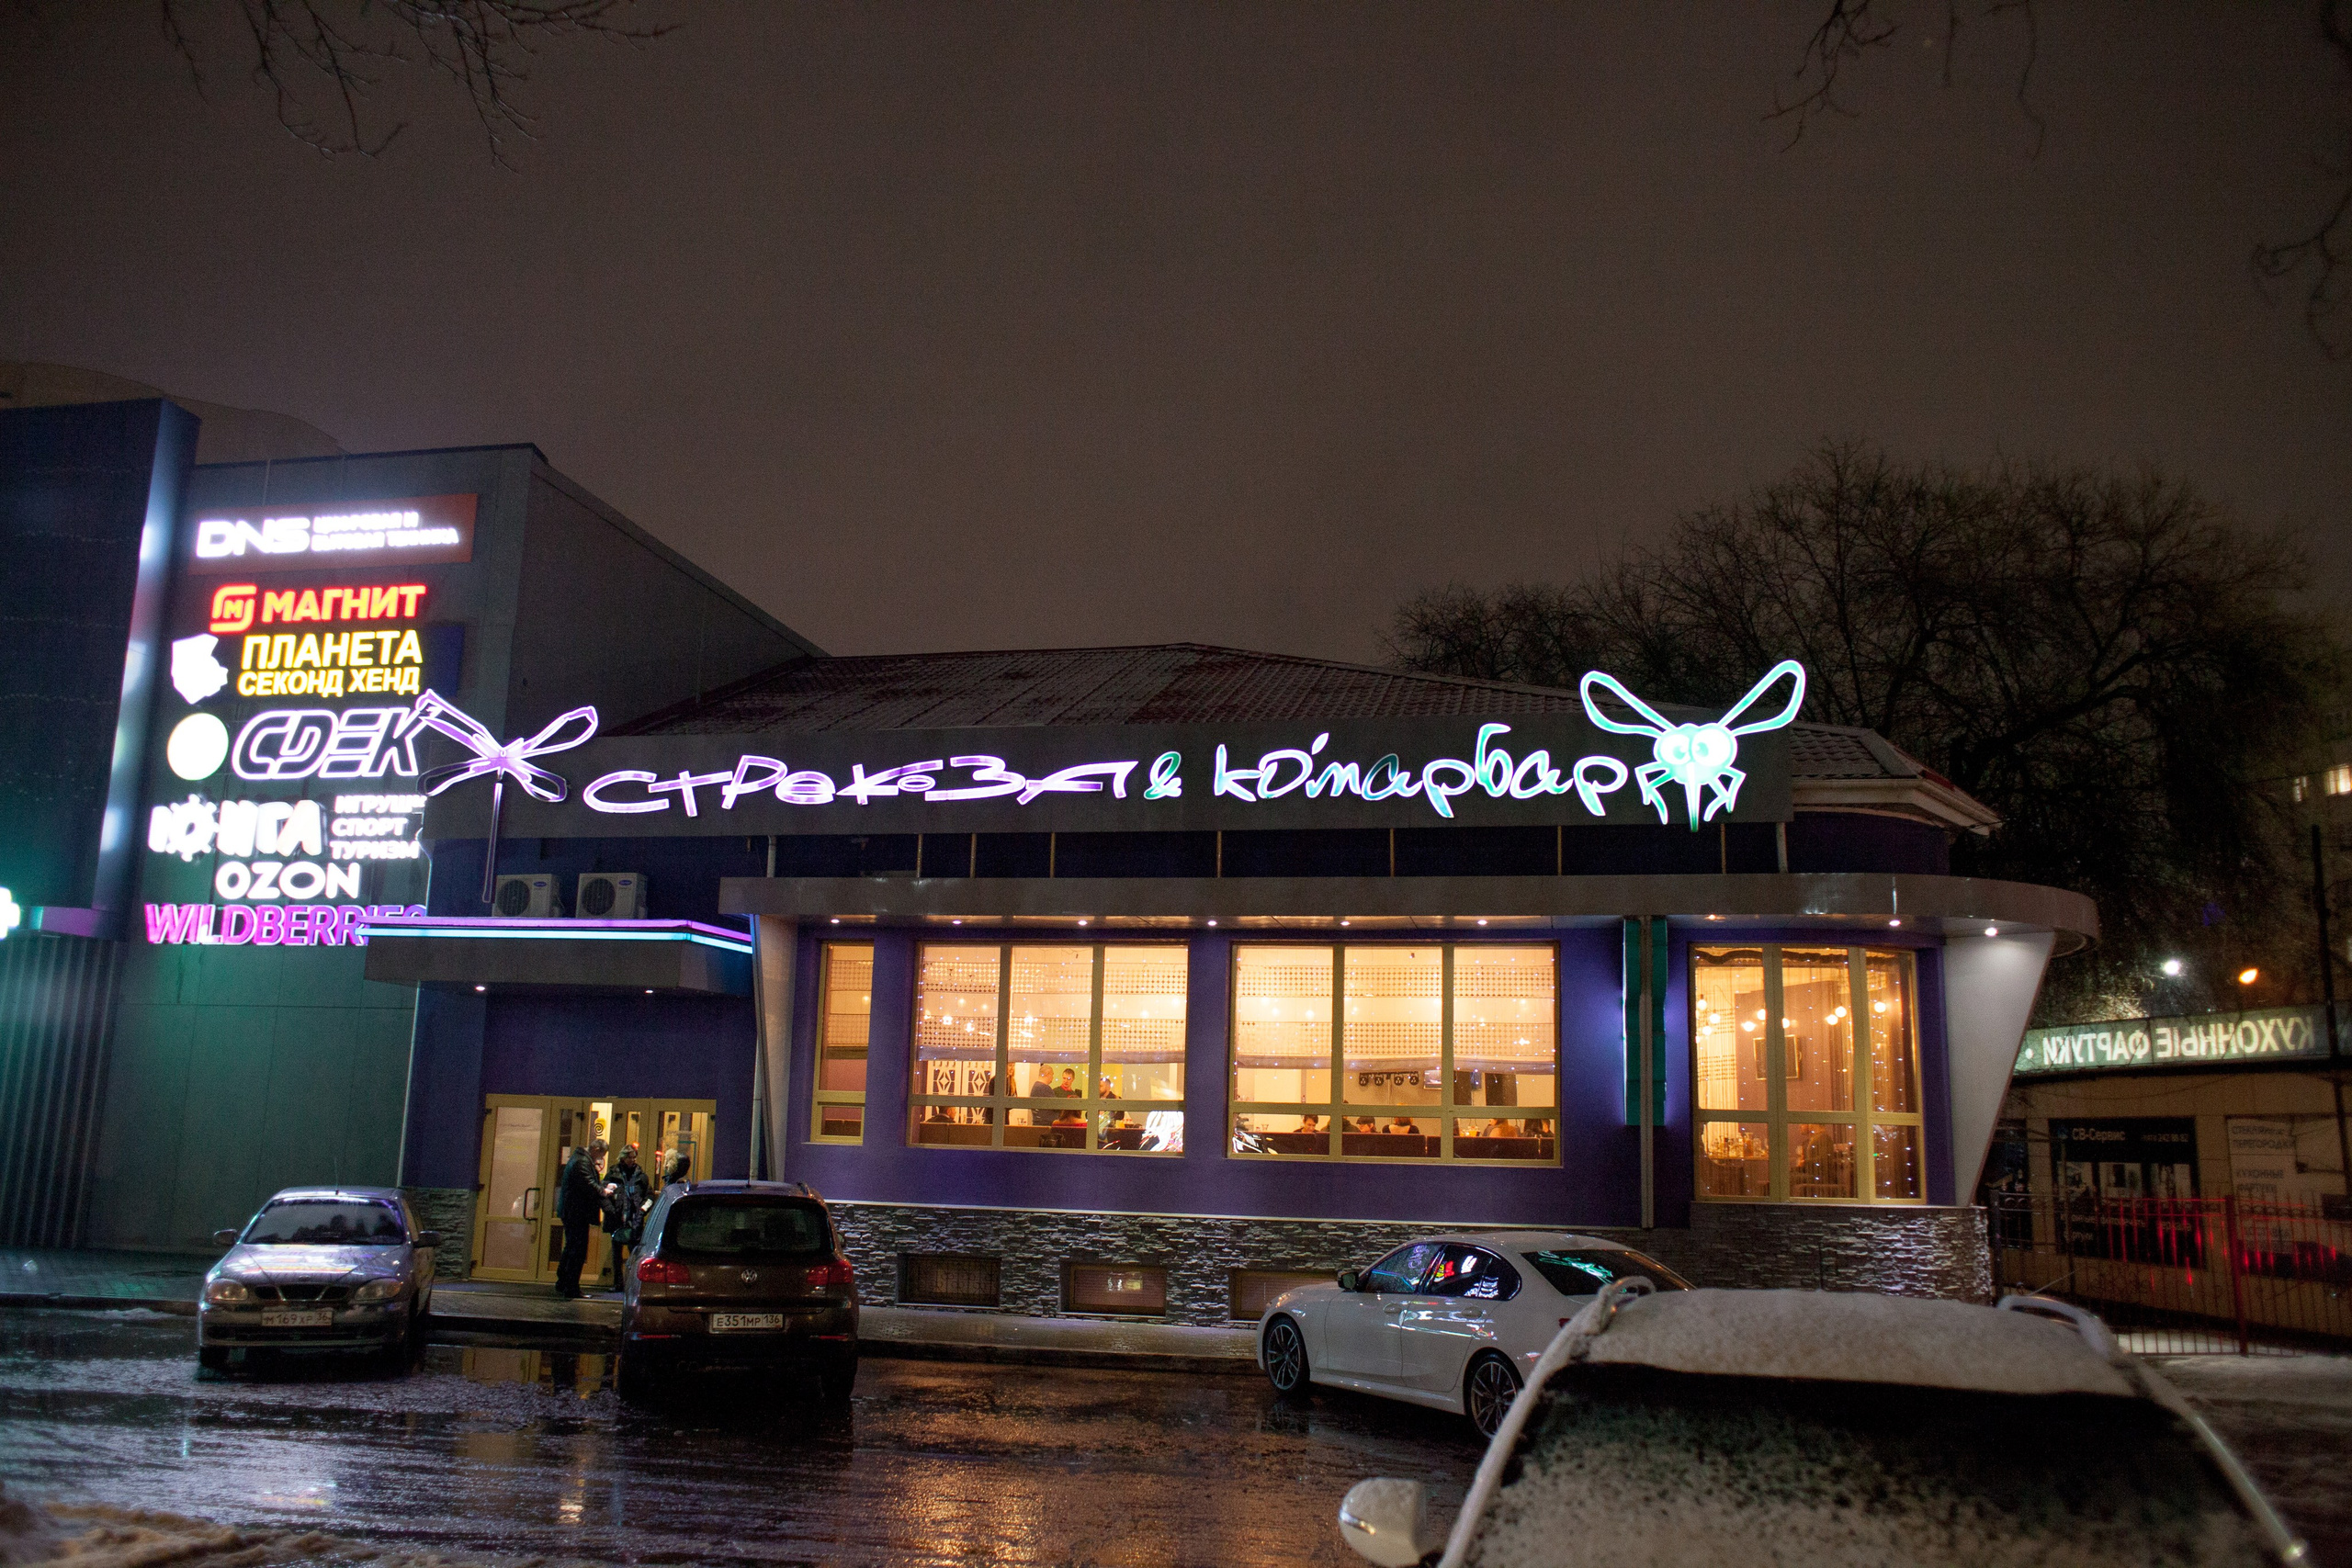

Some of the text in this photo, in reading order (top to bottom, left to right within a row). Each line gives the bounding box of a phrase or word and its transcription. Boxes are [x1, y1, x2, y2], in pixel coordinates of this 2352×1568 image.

[196, 516, 311, 558] DNS
[262, 585, 426, 624] МАГНИТ
[242, 629, 424, 671] ПЛАНЕТА
[237, 666, 421, 698] СЕКОНД ХЕНД
[1143, 750, 1182, 800] &
[332, 818, 408, 837] СПОРТ
[329, 840, 421, 860] ТУРИЗМ
[215, 861, 361, 900] OZON
[144, 904, 427, 946] WILDBERR
[2072, 1127, 2126, 1144] СВ-Сервис
[717, 1314, 780, 1326] Е351МР 136
